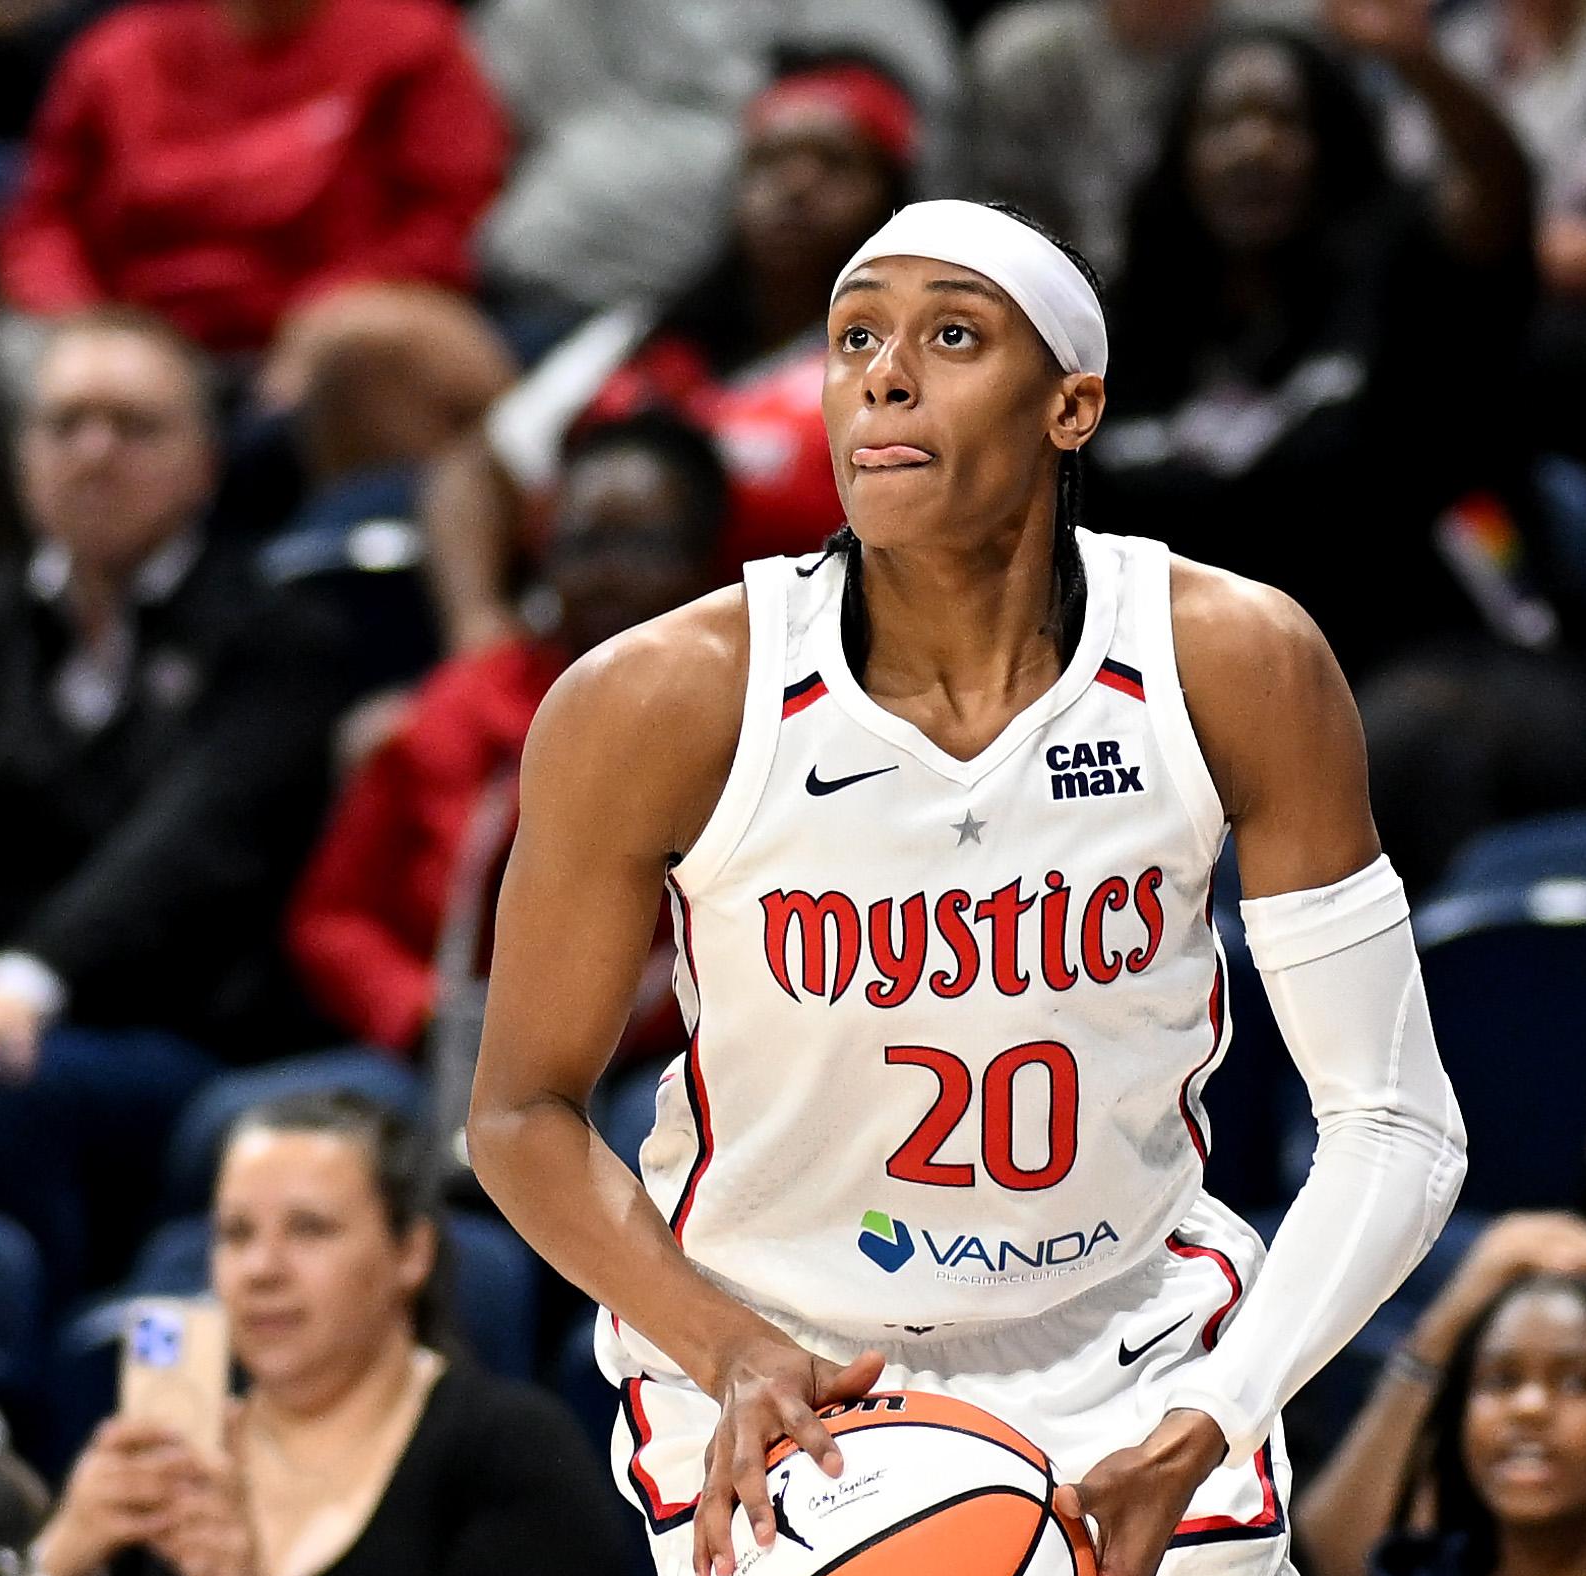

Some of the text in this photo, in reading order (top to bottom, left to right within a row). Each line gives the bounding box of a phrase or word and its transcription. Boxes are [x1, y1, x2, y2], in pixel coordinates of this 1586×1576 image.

[1045, 740, 1122, 772] CAR
[1051, 766, 1145, 800] max
[884, 1040, 1080, 1192] 20
[921, 1220, 1120, 1272] VANDA
